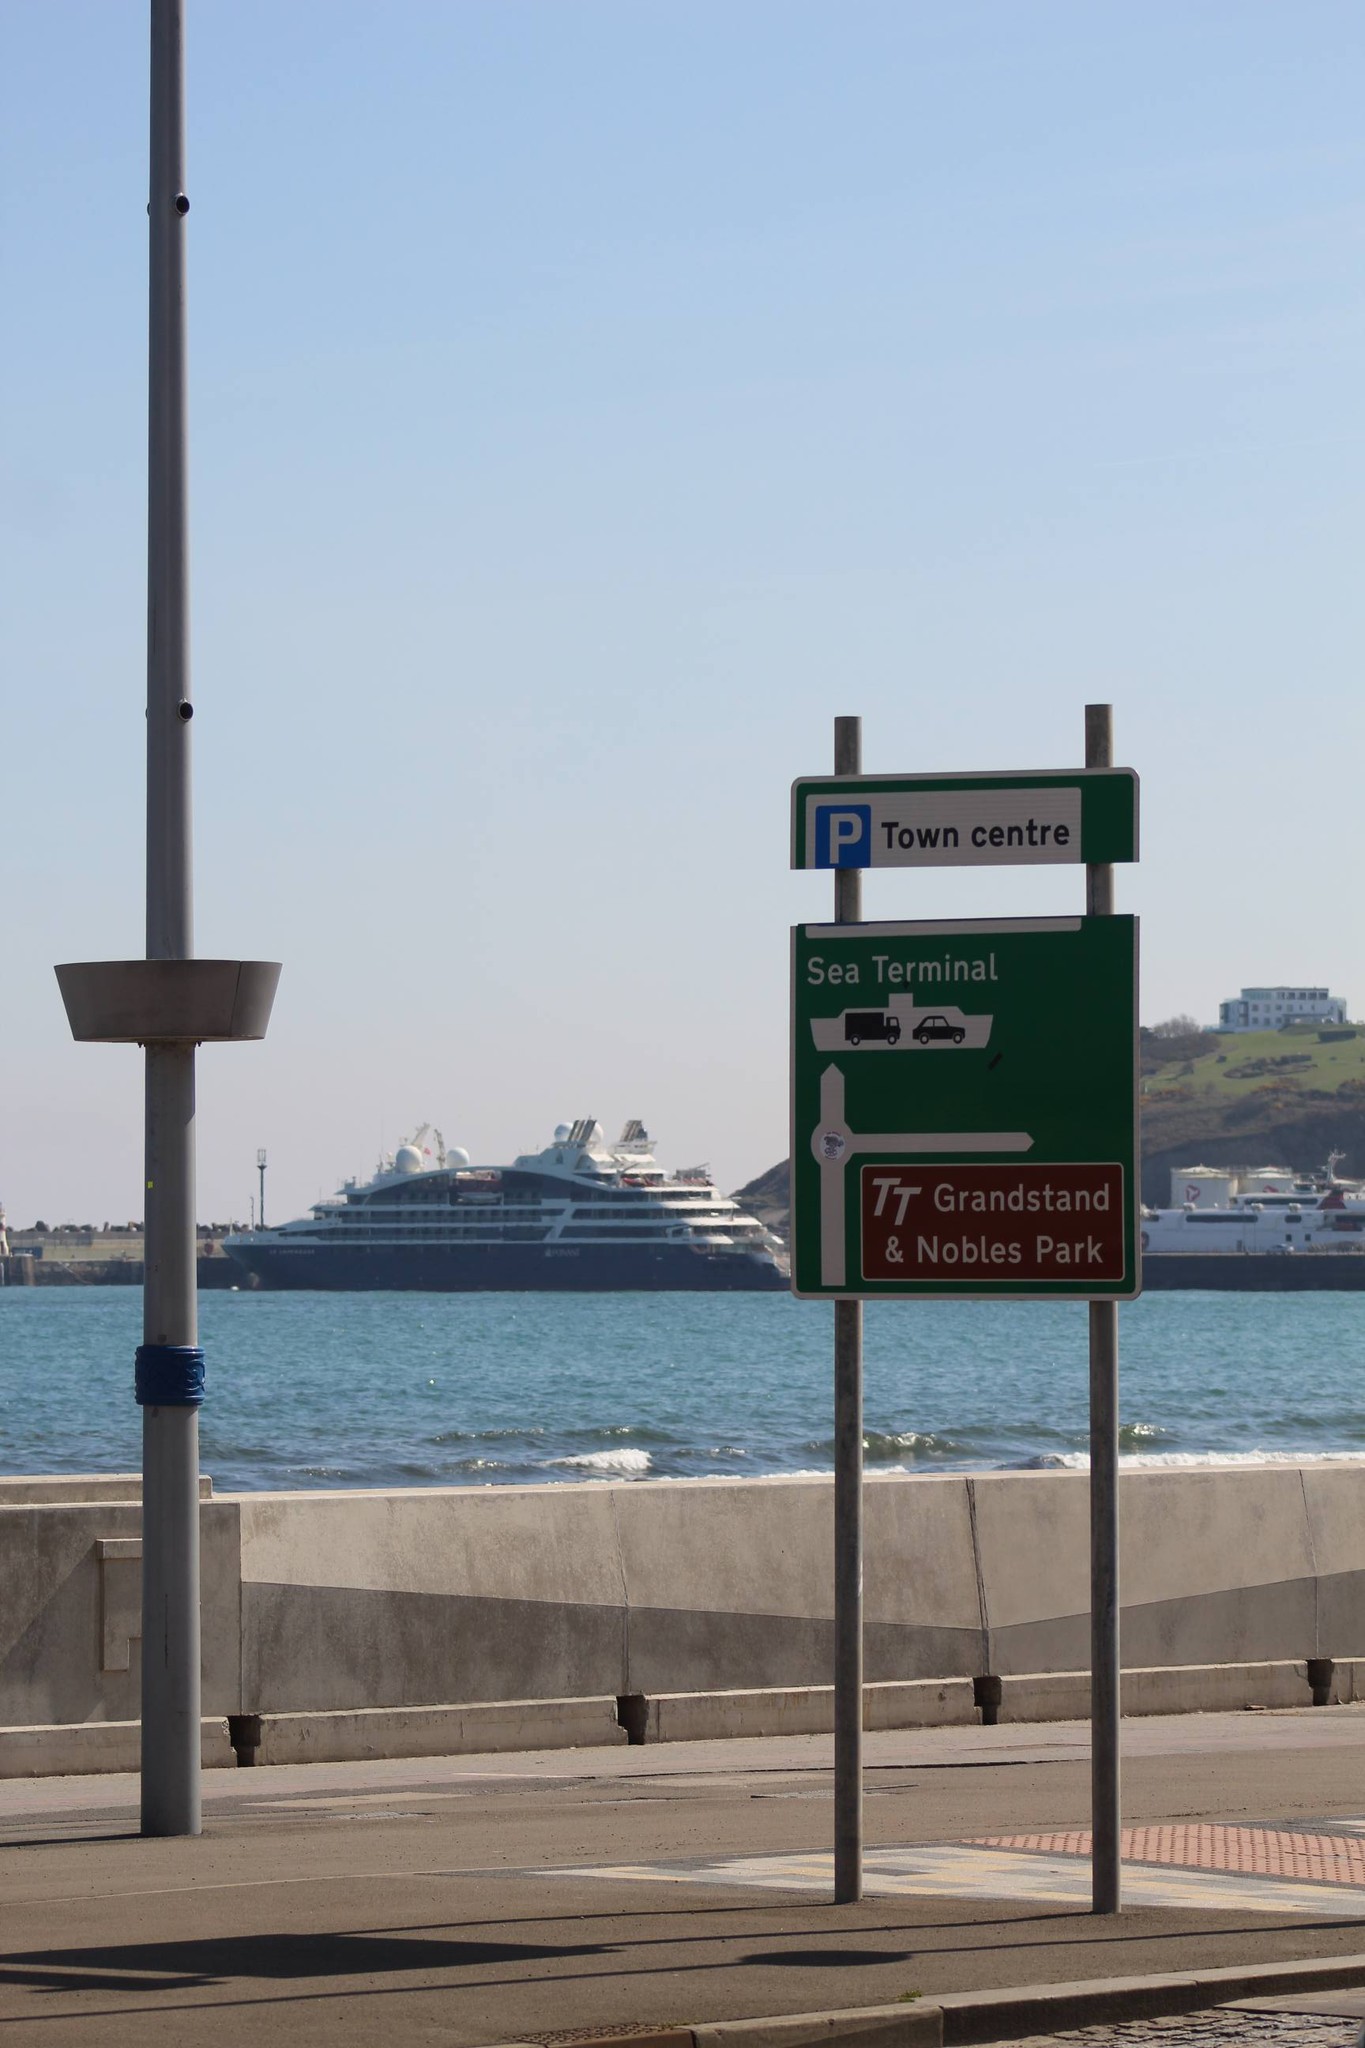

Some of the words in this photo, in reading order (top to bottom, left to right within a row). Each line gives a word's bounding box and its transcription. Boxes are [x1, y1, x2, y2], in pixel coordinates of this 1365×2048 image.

[829, 813, 863, 864] P
[881, 821, 960, 849] Town
[970, 818, 1070, 847] centre
[807, 956, 860, 985] Sea
[872, 953, 999, 984] Terminal
[872, 1178, 922, 1226] TT
[934, 1183, 1110, 1213] Grandstand
[885, 1235, 904, 1263] &
[917, 1235, 1022, 1264] Nobles
[1036, 1235, 1104, 1264] Park
